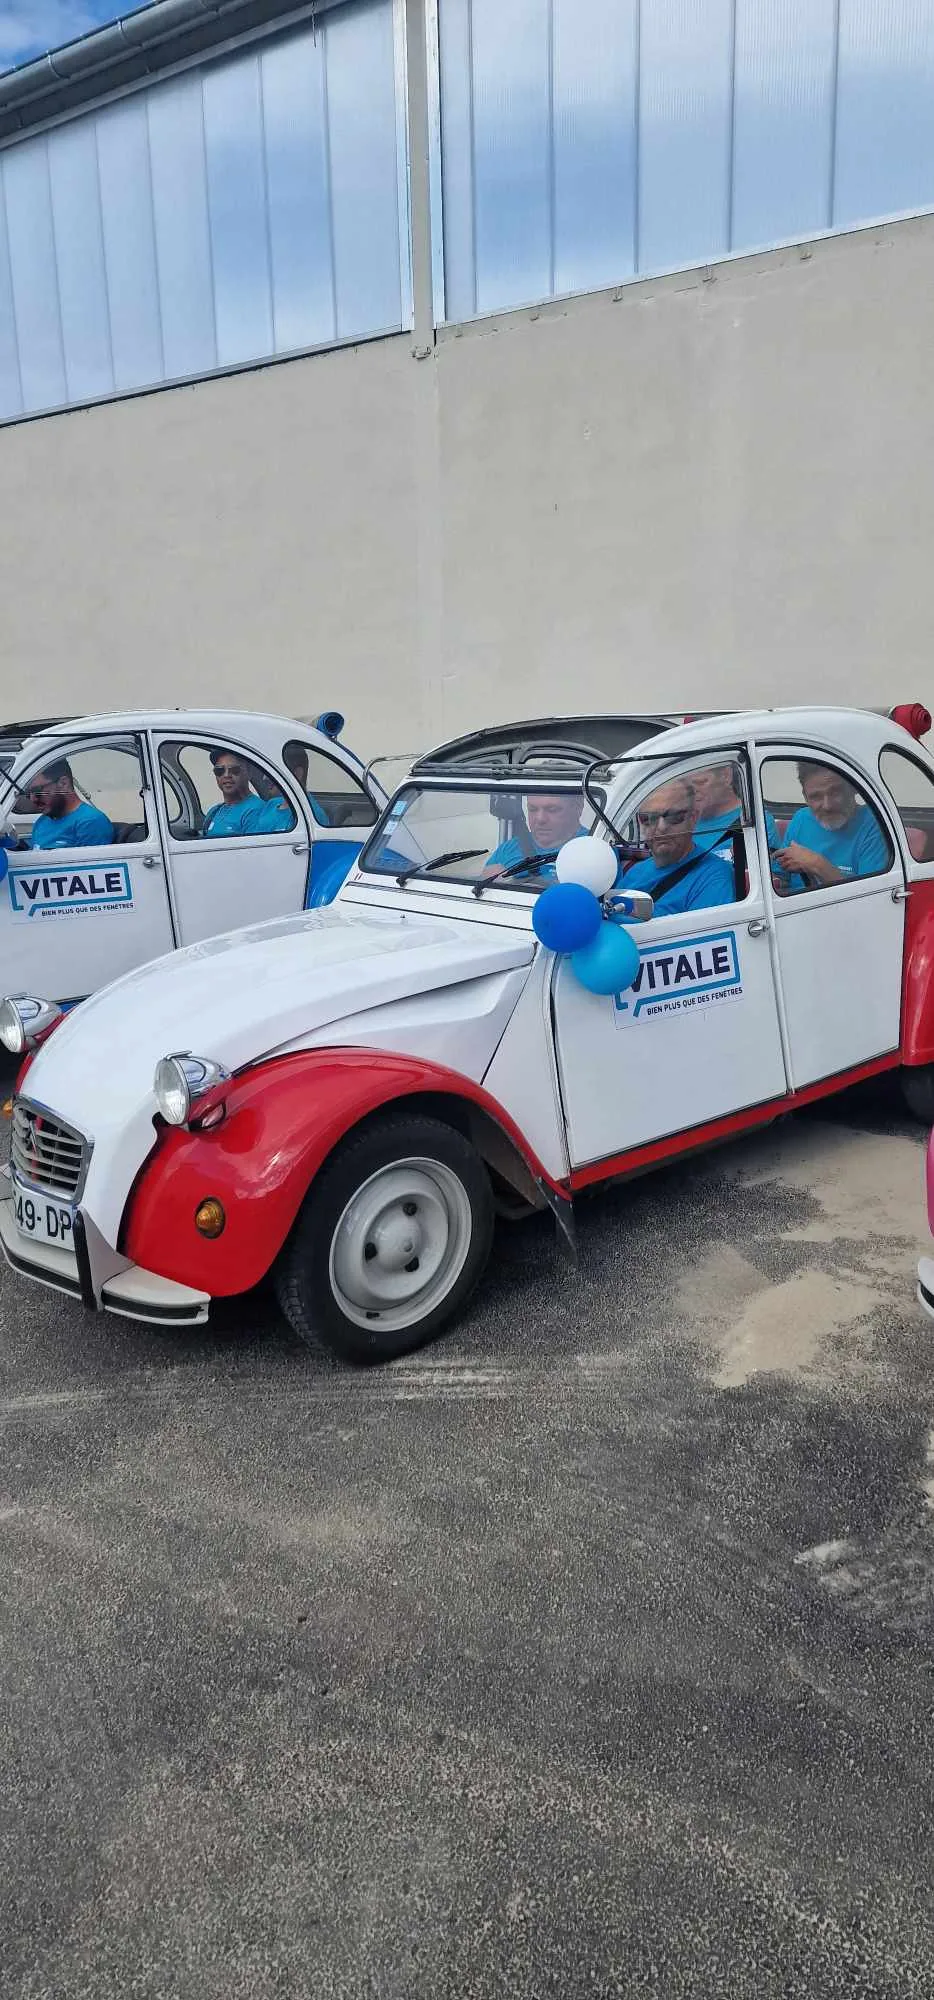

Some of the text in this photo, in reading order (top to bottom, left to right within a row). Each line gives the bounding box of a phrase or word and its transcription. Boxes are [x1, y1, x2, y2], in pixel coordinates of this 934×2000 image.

[20, 872, 122, 900] VITALE
[41, 909, 57, 917] BIEN
[75, 906, 89, 914] QUE
[647, 1006, 663, 1016] BIEN
[664, 1001, 681, 1012] PLUS
[682, 997, 696, 1008] QUE
[697, 994, 710, 1004] DES
